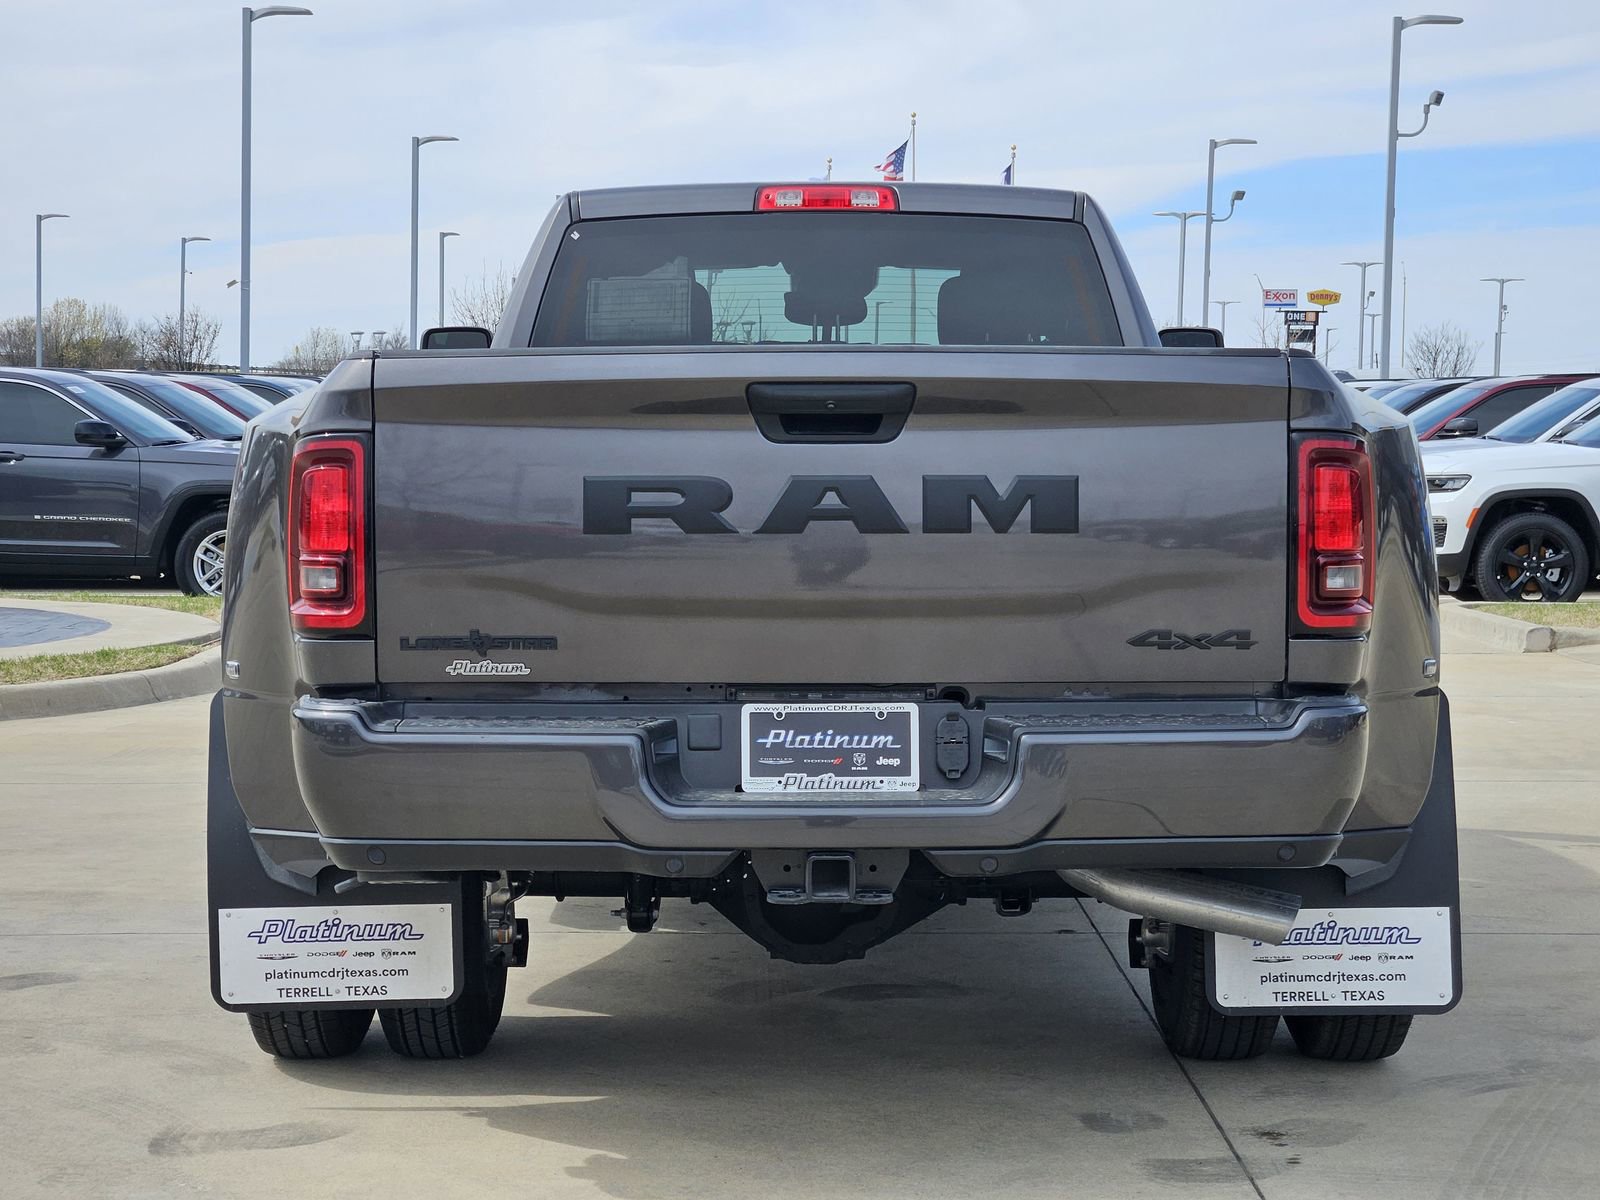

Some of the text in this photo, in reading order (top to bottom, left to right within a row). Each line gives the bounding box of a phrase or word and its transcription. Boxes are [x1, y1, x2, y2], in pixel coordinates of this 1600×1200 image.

[1265, 290, 1296, 302] Exxon
[1310, 292, 1338, 301] Denny's
[1287, 312, 1306, 320] ONE
[583, 474, 1079, 534] RAM
[446, 660, 531, 675] Platinum
[756, 730, 901, 748] Platinum
[876, 757, 900, 767] Jeep
[783, 776, 881, 790] Platinum
[247, 918, 424, 944] Platinum
[1348, 954, 1371, 962] Jeep
[265, 967, 408, 981] platinumcdrjtexas.com
[1260, 972, 1406, 985] platinumcdrjtexas.com
[277, 986, 388, 998] TERRELL TEXAS
[1272, 991, 1385, 1001] TERRELL TEXAS
